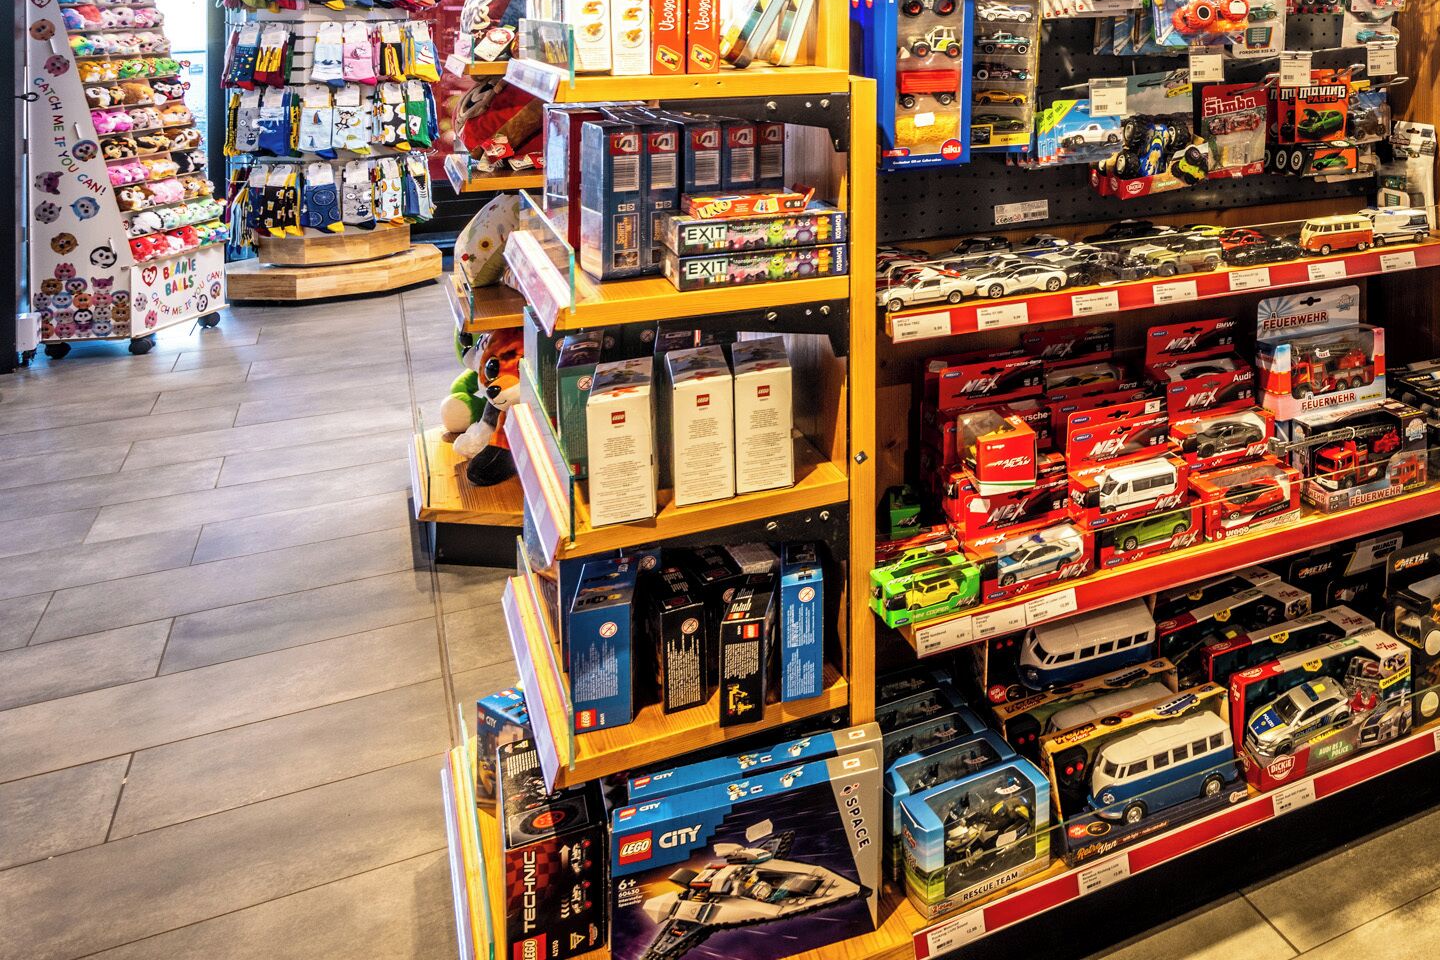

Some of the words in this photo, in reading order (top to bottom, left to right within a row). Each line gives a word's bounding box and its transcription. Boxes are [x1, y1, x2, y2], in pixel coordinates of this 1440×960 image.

[33, 77, 64, 112] CATCH
[1299, 85, 1346, 100] MOVING
[1307, 95, 1338, 104] PARTS
[1205, 95, 1256, 118] Simba
[52, 114, 65, 132] ME
[53, 136, 66, 148] IF
[942, 145, 961, 155] siku
[57, 150, 81, 173] YOU
[77, 173, 107, 196] CAN!
[697, 200, 732, 219] UNO
[687, 226, 725, 242] EXIT
[162, 257, 197, 280] BEANIE
[688, 259, 726, 276] EXIT
[164, 274, 194, 297] BALLS
[172, 306, 183, 316] ME
[206, 270, 223, 283] CAN!
[1216, 320, 1236, 330] BMW
[1262, 310, 1328, 331] FEUERWEHR
[1164, 333, 1200, 351] NEX
[960, 374, 1002, 394] NEX
[1233, 373, 1252, 383] Audi
[1185, 389, 1217, 409] NEX
[1301, 392, 1356, 412] FEUERWEHR
[1020, 412, 1048, 422] orsche
[1090, 432, 1127, 456] NEX
[1155, 491, 1184, 510] NEX
[1349, 486, 1402, 507] FEUERWEHR
[987, 498, 1029, 524] NEX
[1058, 557, 1089, 580] NEX
[1400, 551, 1430, 567] METAL
[1382, 675, 1399, 688] OPENING
[1398, 667, 1412, 680] DOORS
[485, 715, 497, 728] CITY
[580, 710, 592, 728] LEGO
[1262, 712, 1276, 728] POLIZEI
[1318, 746, 1331, 756] AUDI
[1331, 745, 1350, 757] POLICE
[1270, 758, 1292, 773] DICKIE
[652, 771, 674, 781] CITY
[638, 801, 661, 812] CITY
[844, 796, 870, 850] SPACE
[621, 838, 651, 857] LEGO
[658, 824, 702, 849] CITY
[1076, 839, 1100, 859] Retro
[1098, 838, 1118, 855] Van
[523, 850, 536, 934] TECHNIC
[618, 878, 637, 890] 6+
[618, 888, 640, 898] 60430
[963, 881, 995, 901] RESCUE
[995, 871, 1019, 890] TEAM
